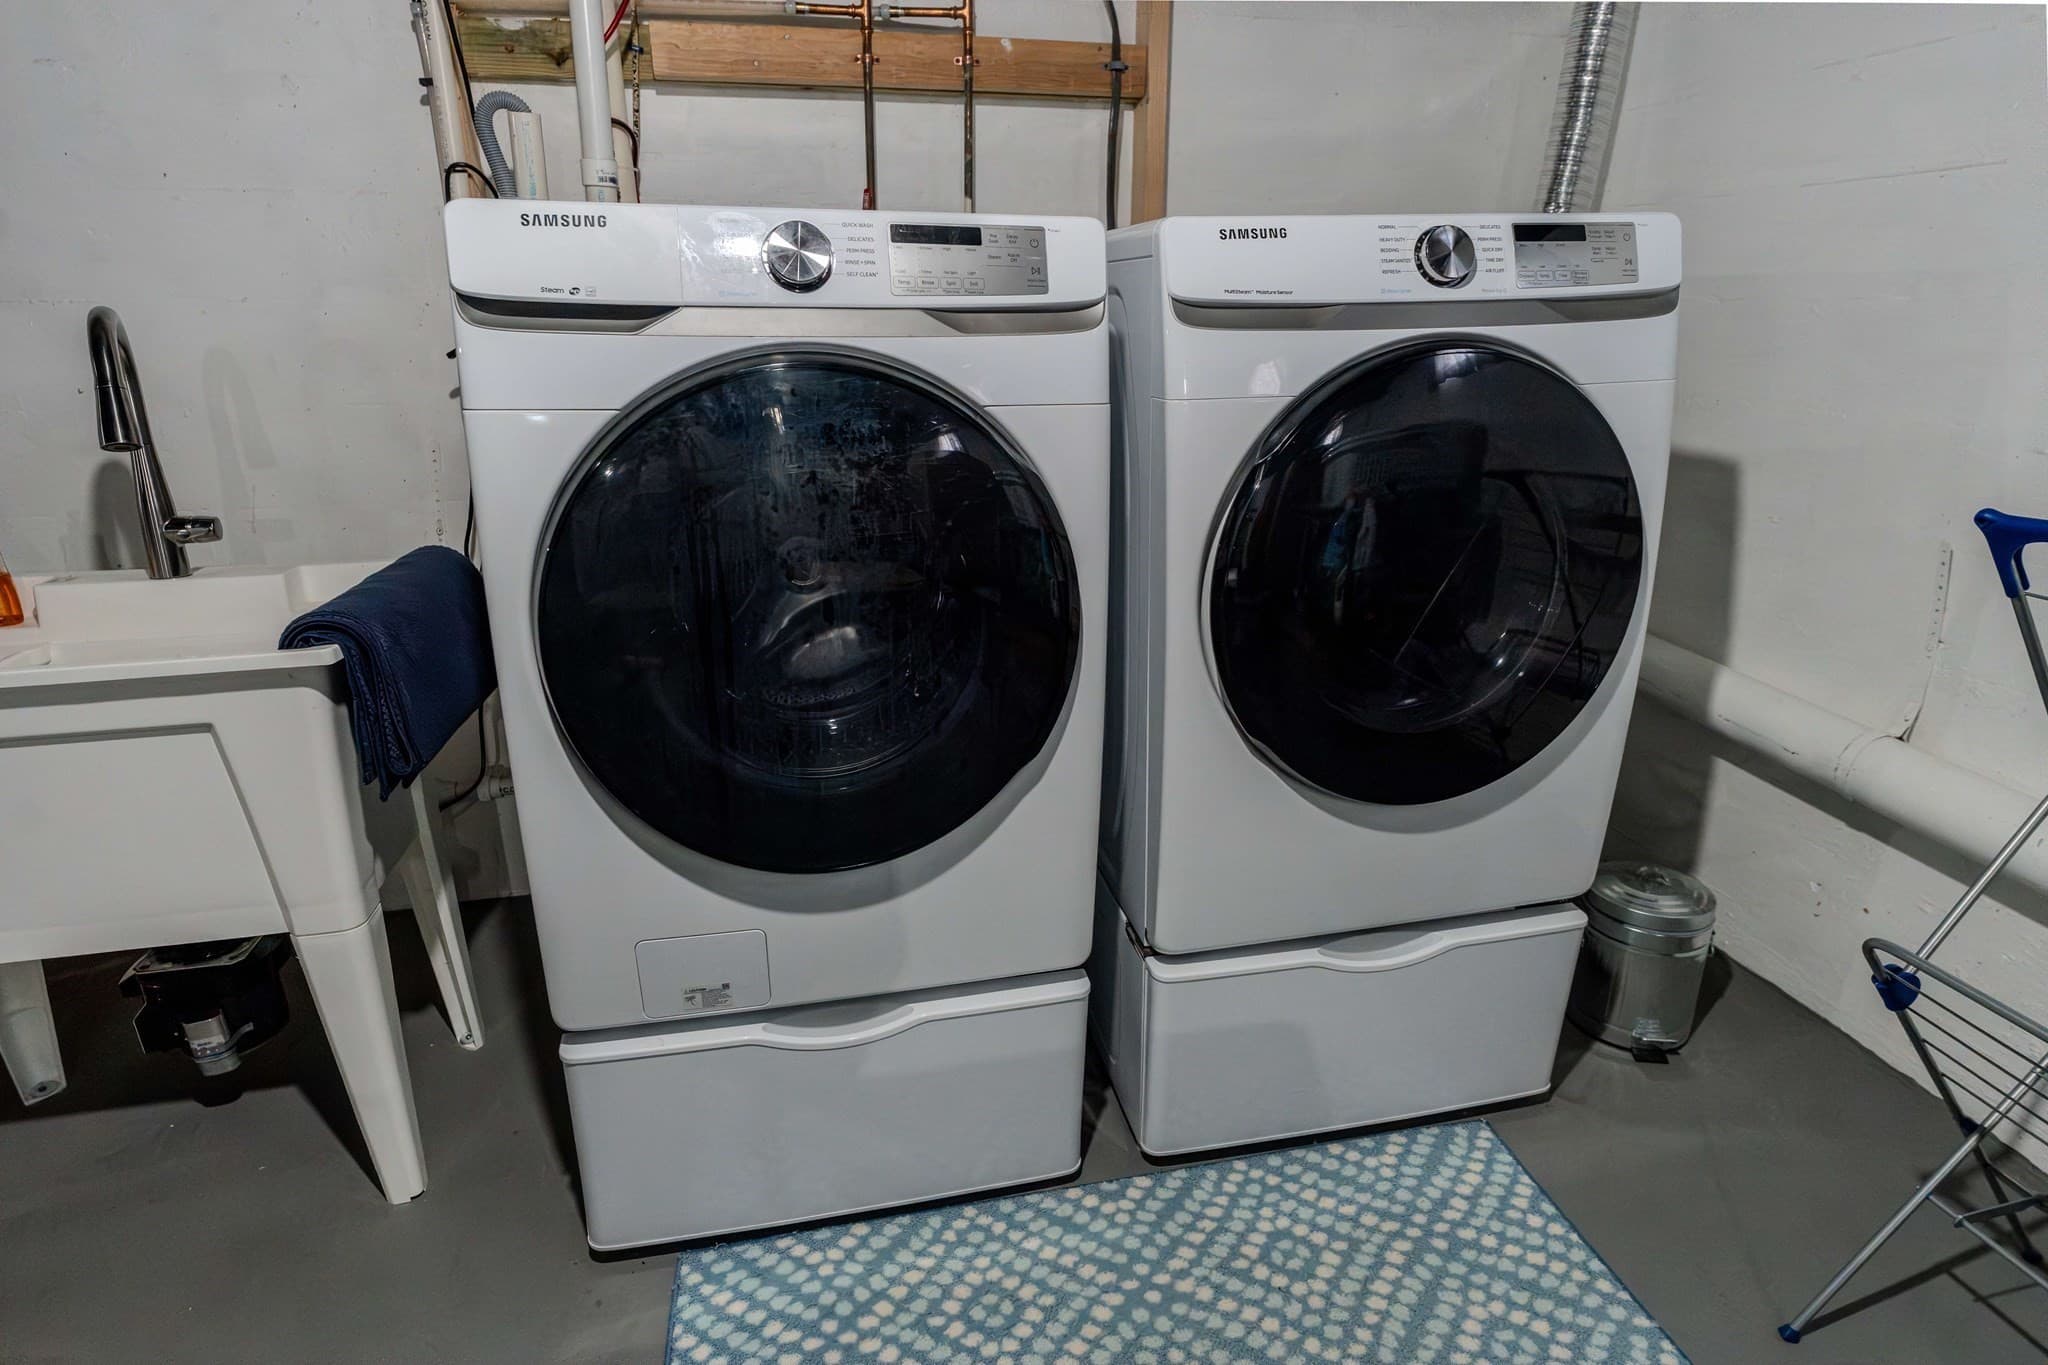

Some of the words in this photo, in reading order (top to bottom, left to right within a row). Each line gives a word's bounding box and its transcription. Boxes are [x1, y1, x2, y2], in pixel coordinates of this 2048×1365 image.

[520, 213, 607, 228] SAMSUNG
[1219, 227, 1288, 240] SAMSUNG
[540, 286, 565, 294] Steam
